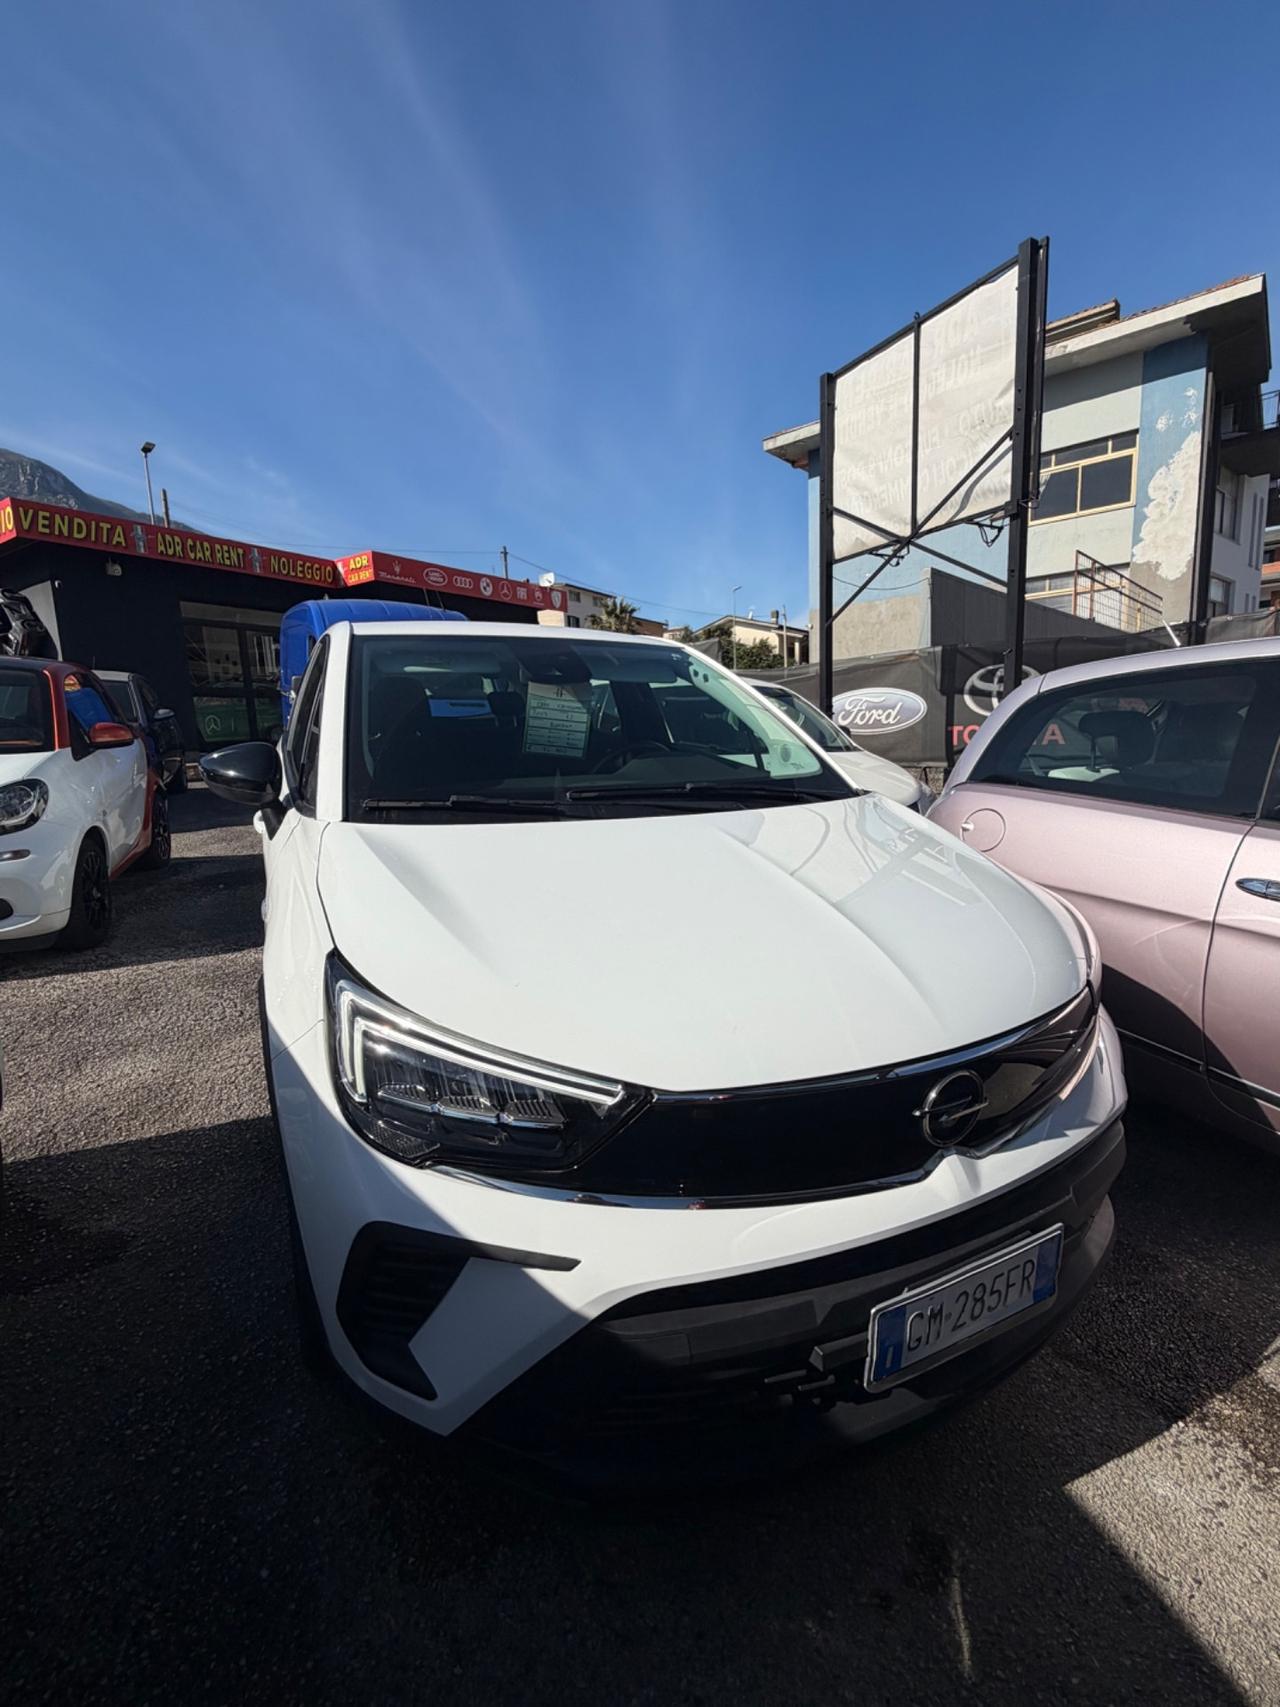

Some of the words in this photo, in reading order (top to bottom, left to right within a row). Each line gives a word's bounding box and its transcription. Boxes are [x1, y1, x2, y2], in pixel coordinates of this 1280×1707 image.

[19, 506, 126, 546] VENDITA
[157, 532, 183, 557] ADR
[187, 538, 213, 563] CAR
[214, 543, 244, 568] RENT
[350, 555, 369, 570] ADR
[270, 555, 333, 583] NOLEGGIO
[838, 697, 902, 726] Ford
